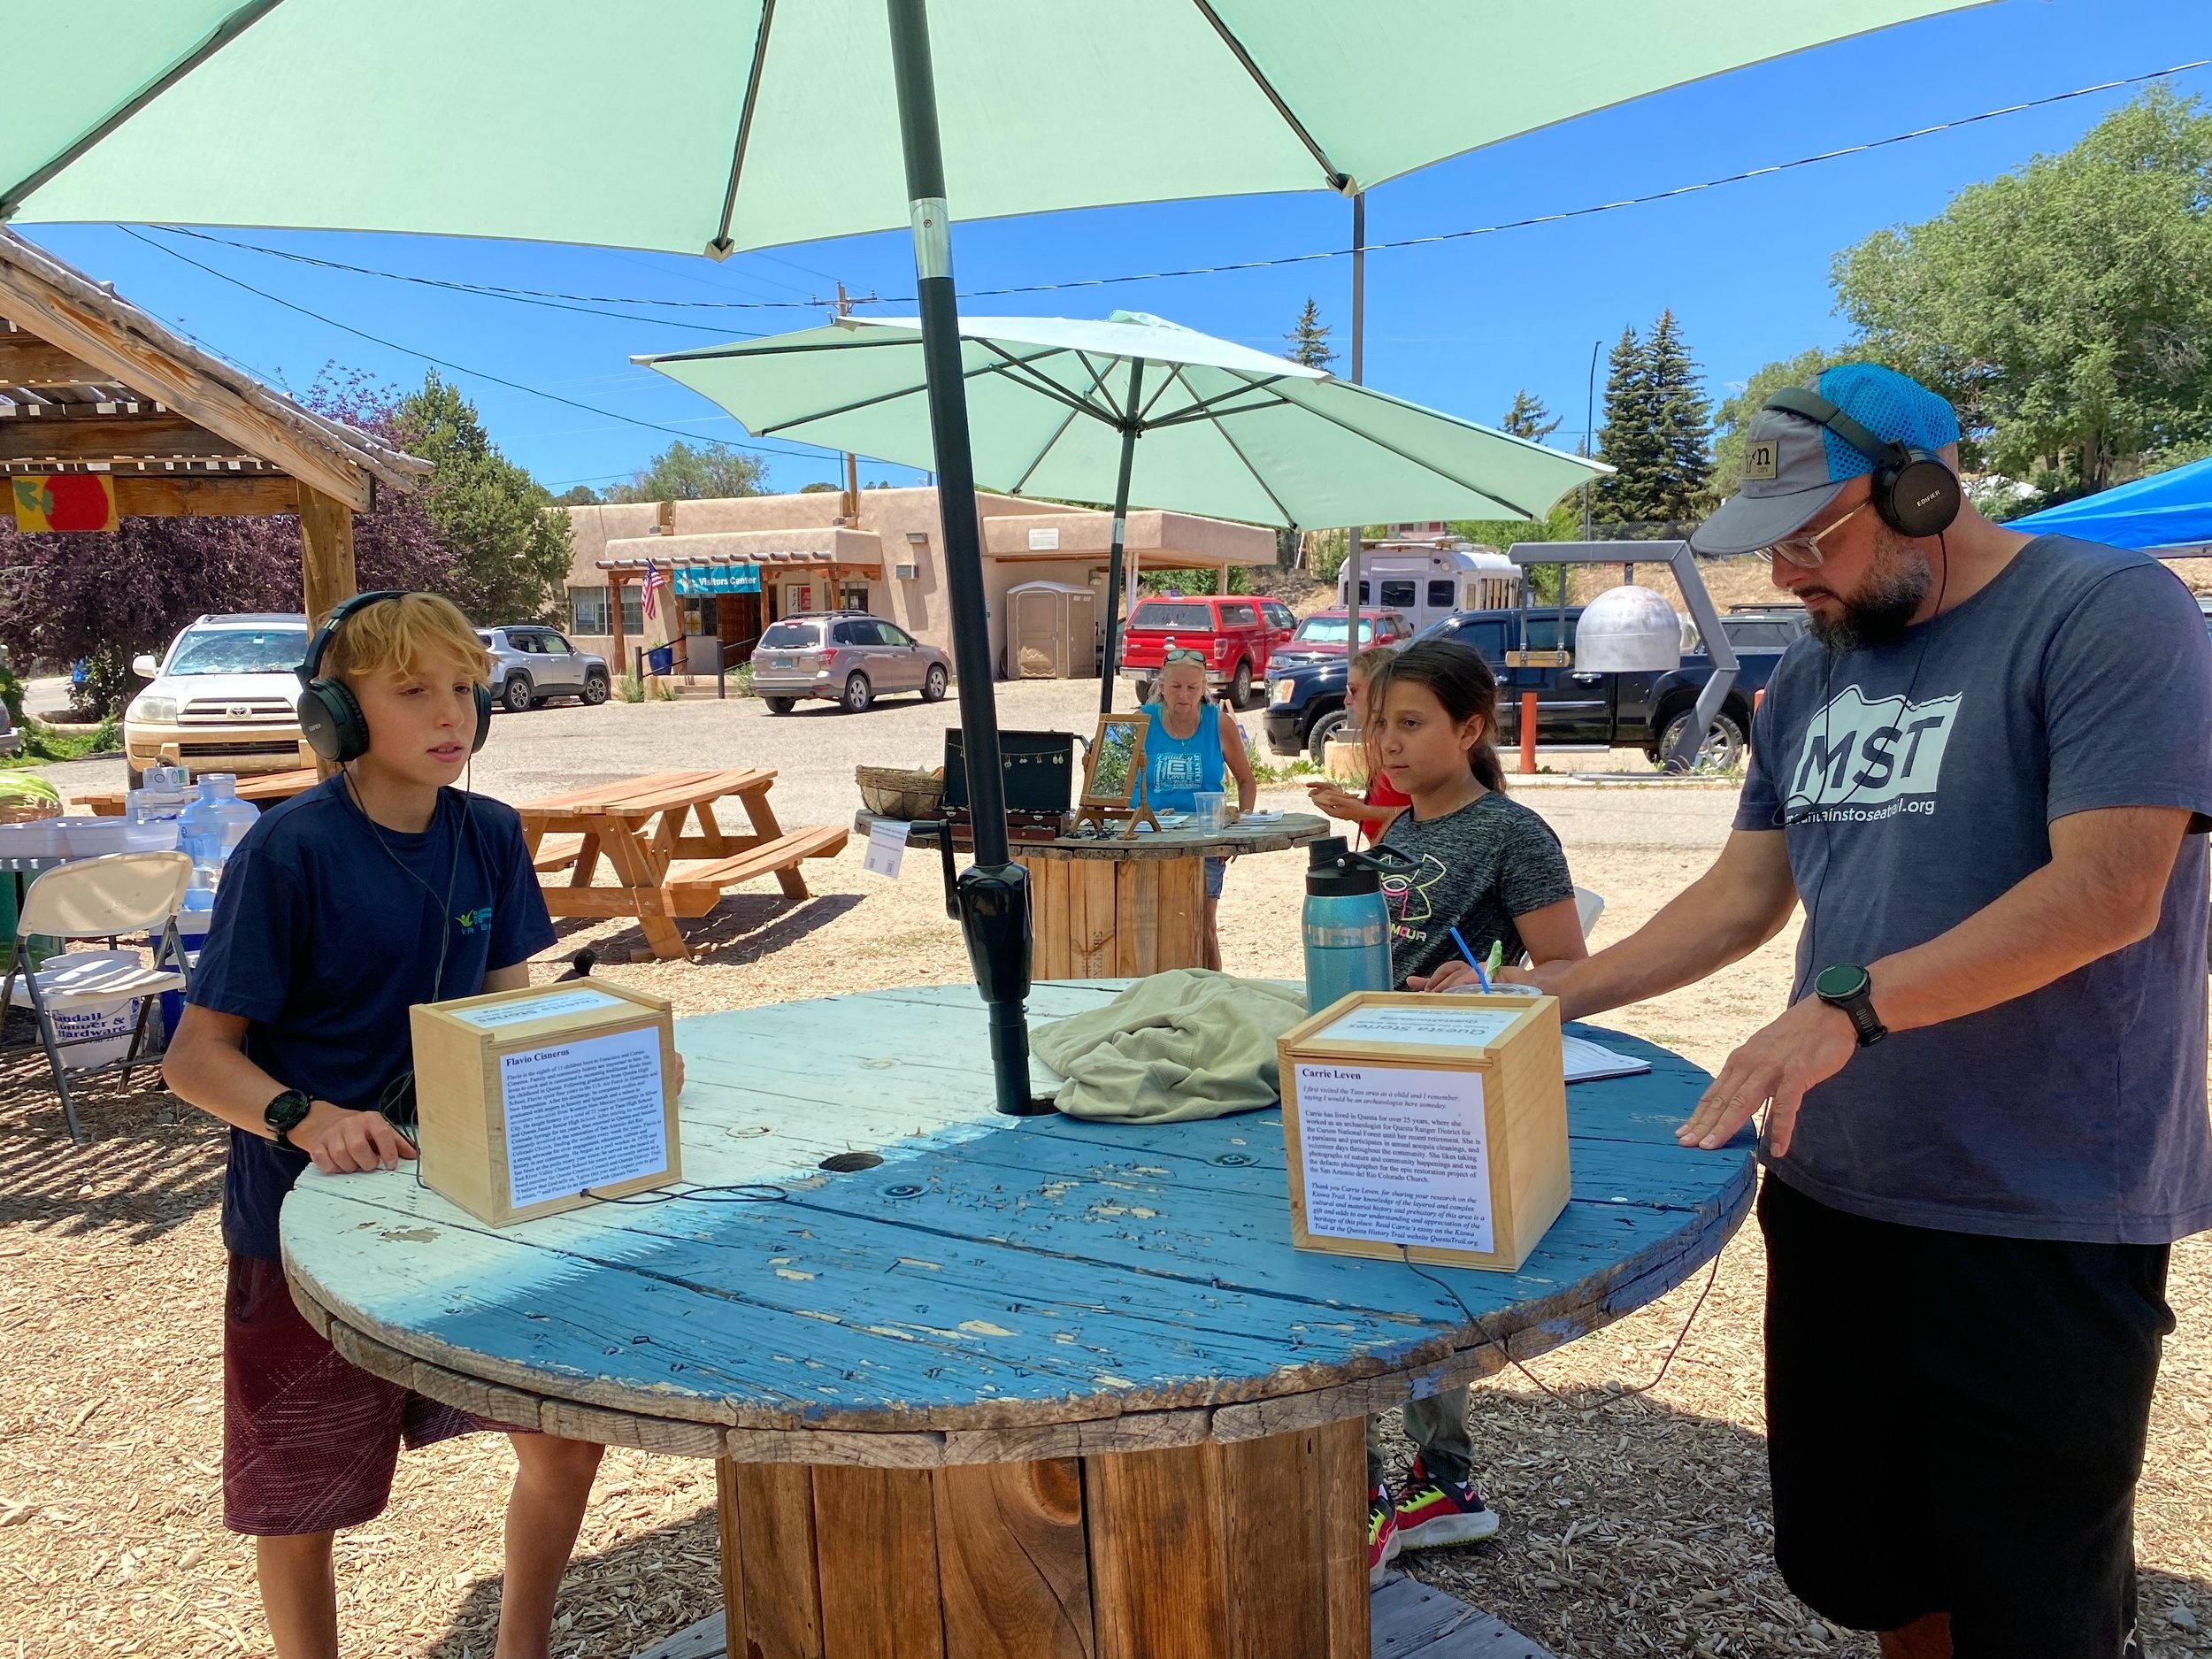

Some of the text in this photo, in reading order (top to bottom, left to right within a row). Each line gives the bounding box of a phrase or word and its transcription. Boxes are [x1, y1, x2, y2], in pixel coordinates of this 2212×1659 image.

[1916, 489, 1940, 507] EDIFIER
[698, 576, 757, 586] Visitors Center
[1796, 715, 1946, 792] MST
[1786, 798, 1935, 826] mntainstoseatrail.org
[1390, 923, 1426, 942] MOUR
[58, 1025, 127, 1038] Hardware
[1348, 1023, 1411, 1032] Stories
[1417, 1025, 1486, 1035] Questa
[506, 1047, 570, 1066] Flavio Cisneros
[1302, 1068, 1360, 1079] Carrie Leven
[1308, 1150, 1342, 1159] photographs
[1416, 1158, 1450, 1168] happenings
[1340, 1161, 1378, 1170] photographer
[1363, 1195, 1394, 1204] knowledge
[1313, 1215, 1336, 1224] heritage
[1368, 1228, 1389, 1237] History
